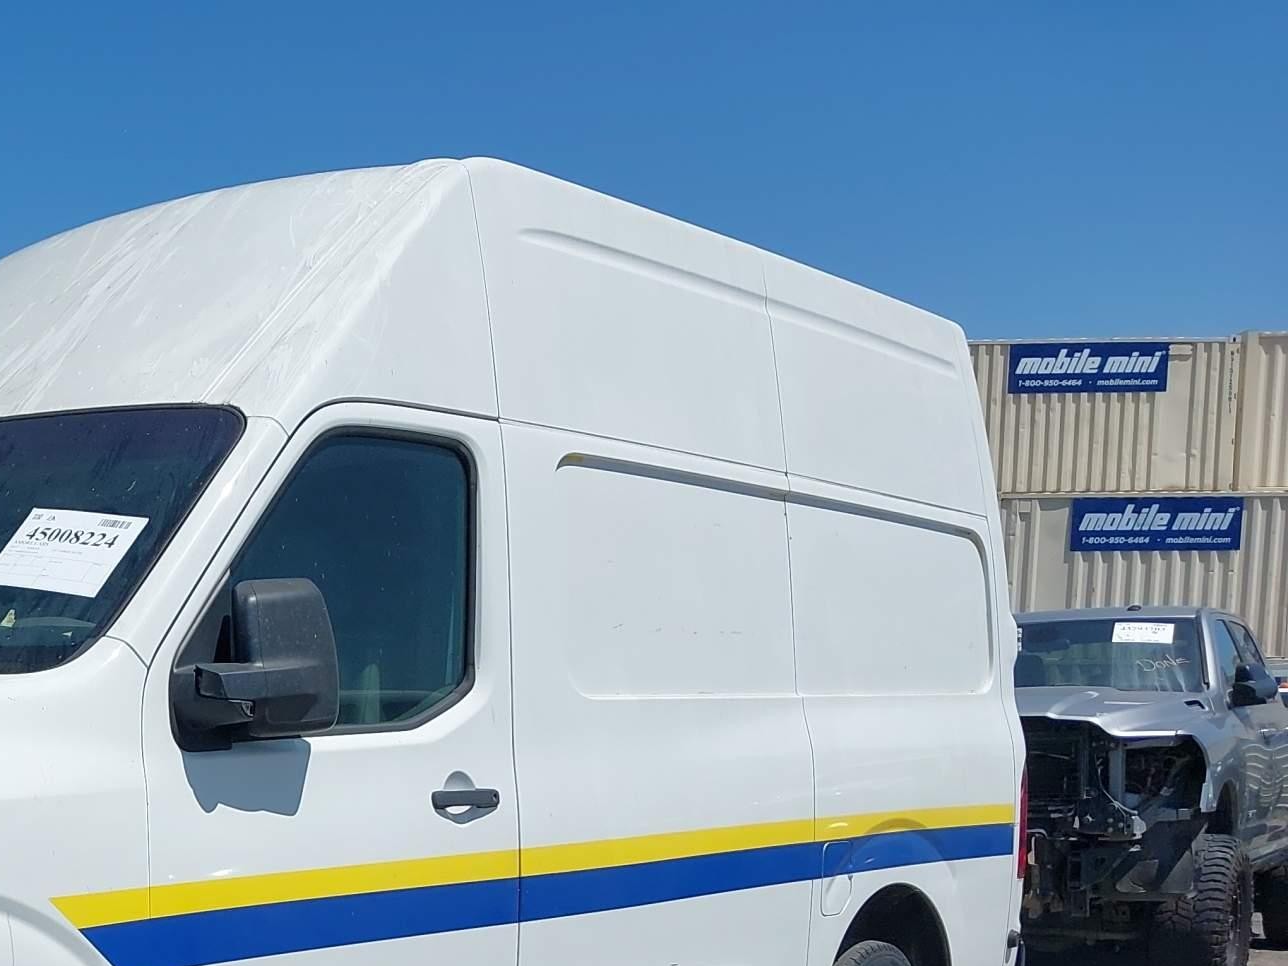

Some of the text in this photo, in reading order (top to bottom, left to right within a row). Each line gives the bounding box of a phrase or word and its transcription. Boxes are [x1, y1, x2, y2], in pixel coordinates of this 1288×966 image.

[1015, 348, 1163, 375] mobile mini
[1018, 378, 1159, 387] 1-800-950-6464 mobilemini.com
[1078, 503, 1236, 531] mobile mini
[26, 526, 120, 548] 45008224
[1081, 536, 1231, 544] 1-800-950-6464 mobilemini.com
